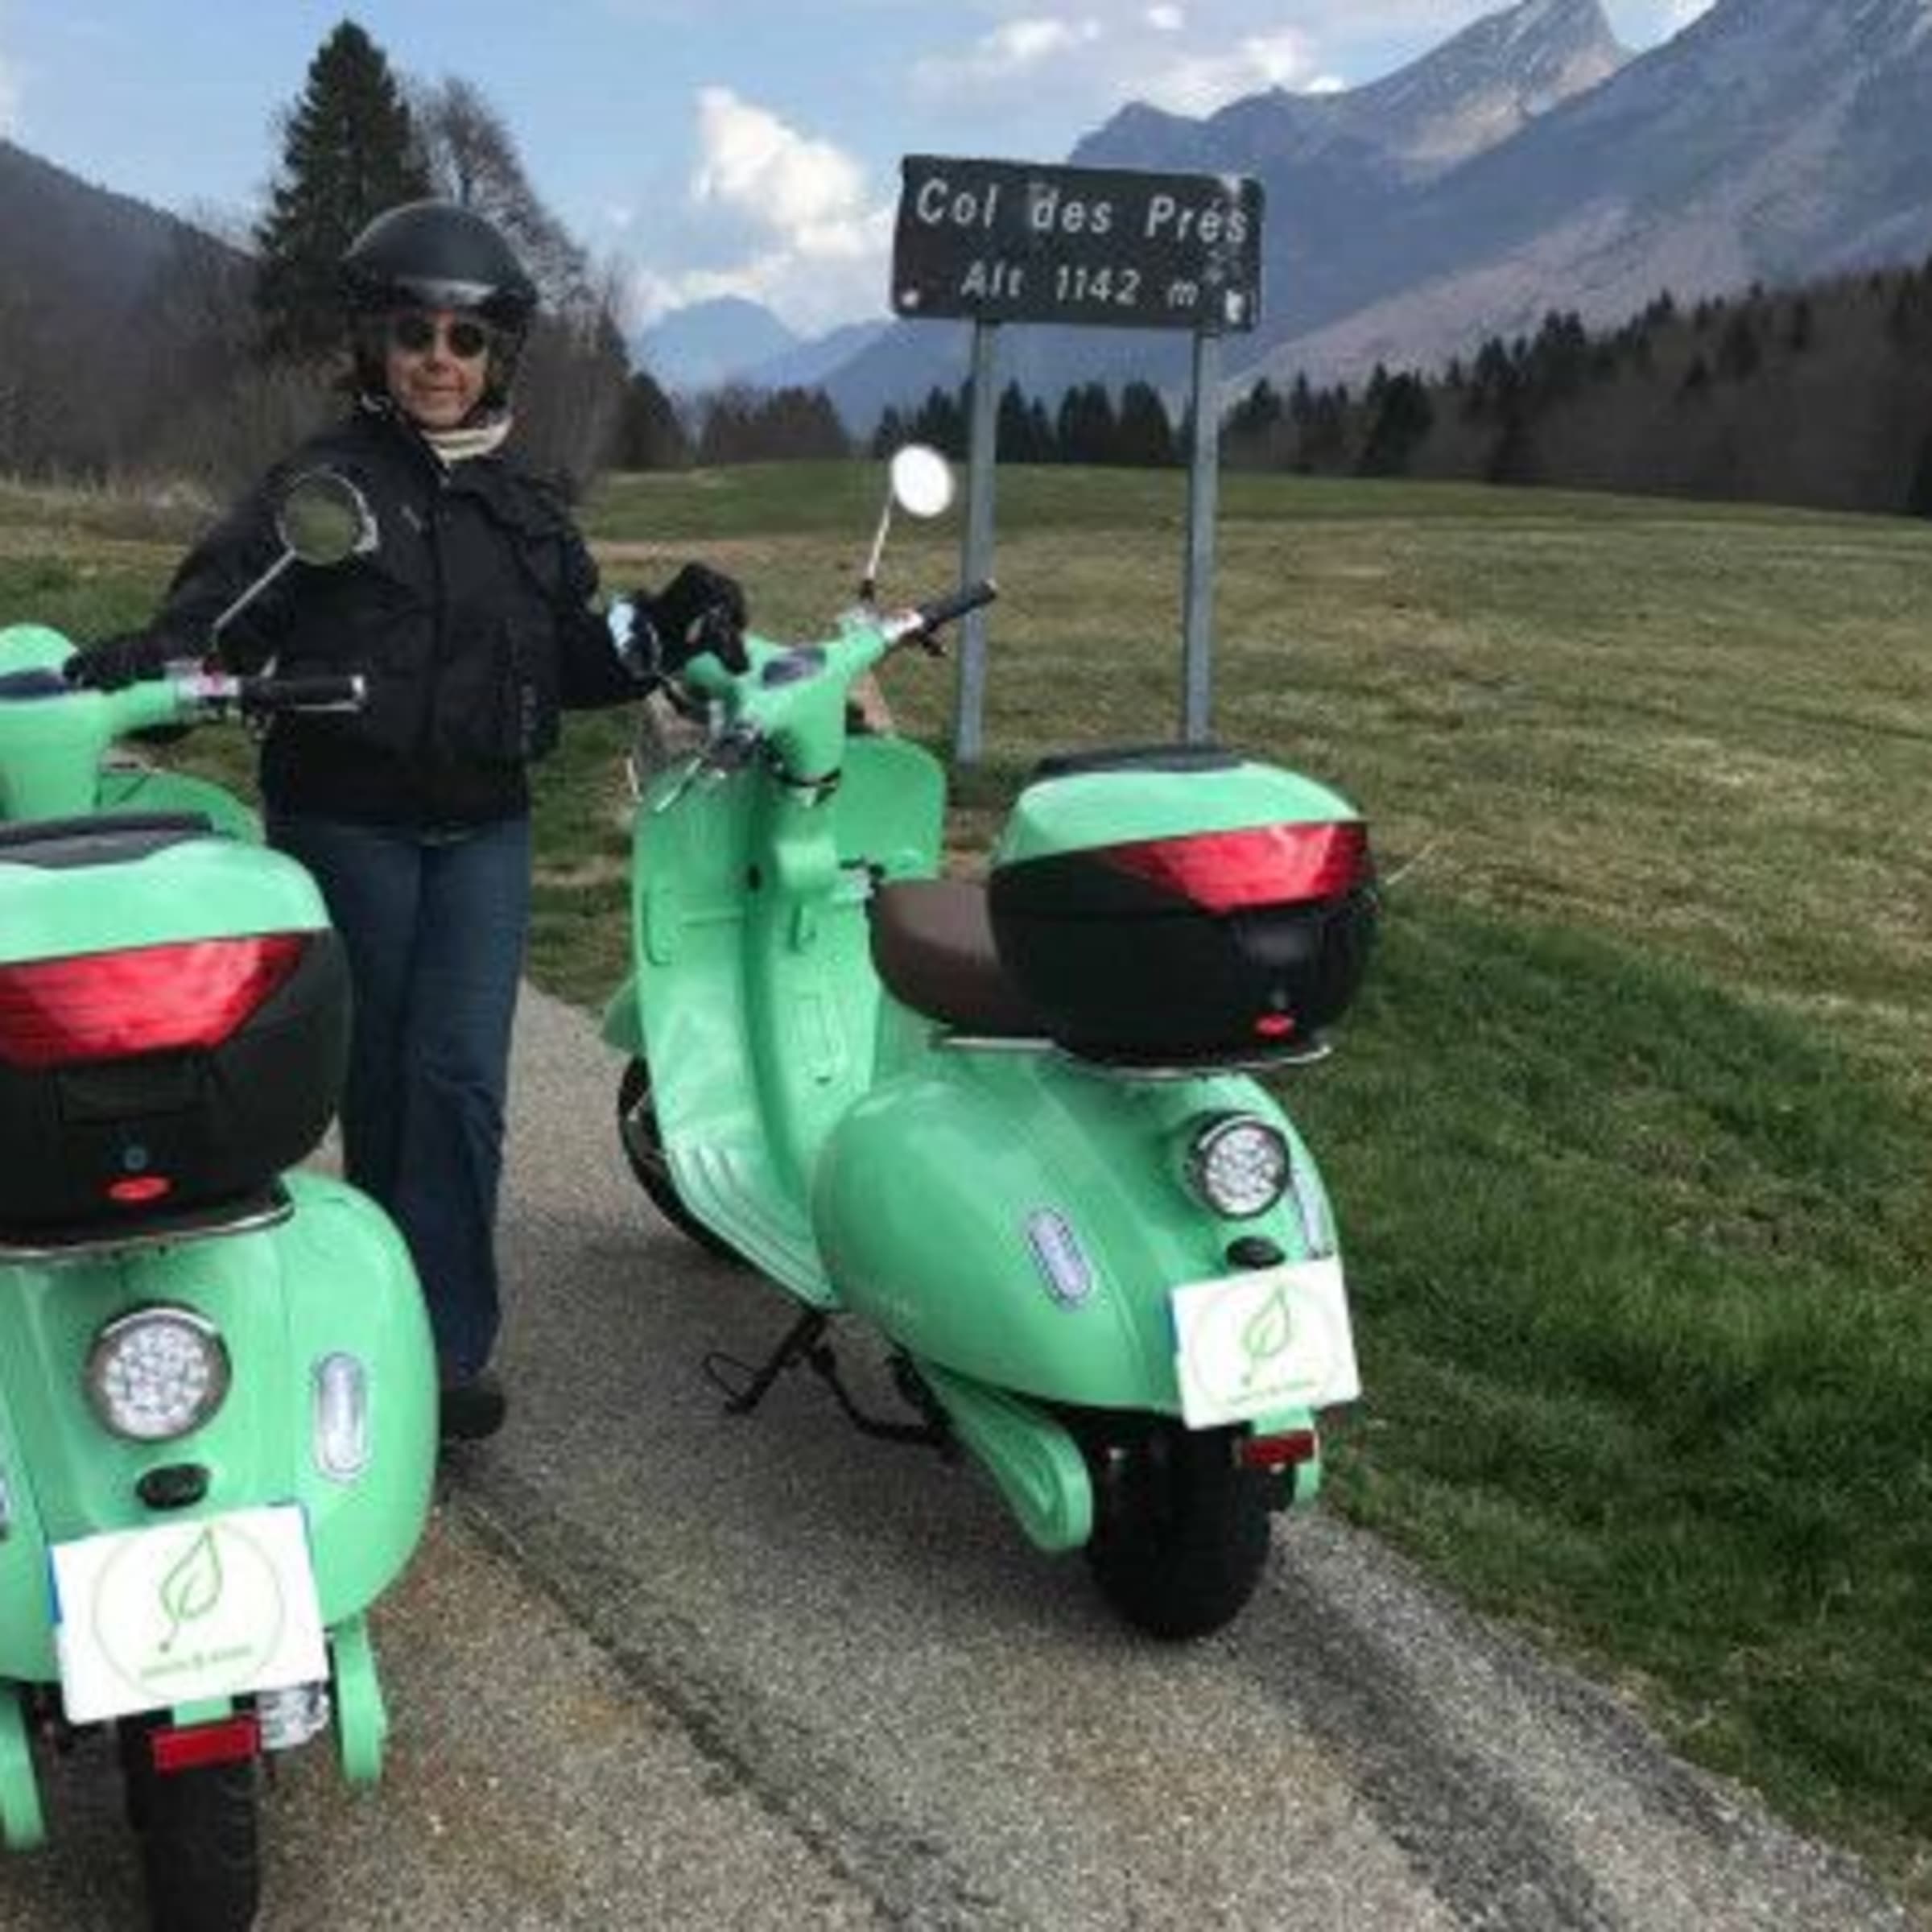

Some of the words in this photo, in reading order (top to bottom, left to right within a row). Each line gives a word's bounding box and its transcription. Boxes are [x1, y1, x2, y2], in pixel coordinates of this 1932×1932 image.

[916, 177, 998, 228] Col
[1030, 184, 1113, 233] des
[1144, 195, 1248, 243] Prés
[960, 260, 1025, 297] Alt
[1056, 266, 1141, 303] 1142
[1167, 282, 1199, 308] m
